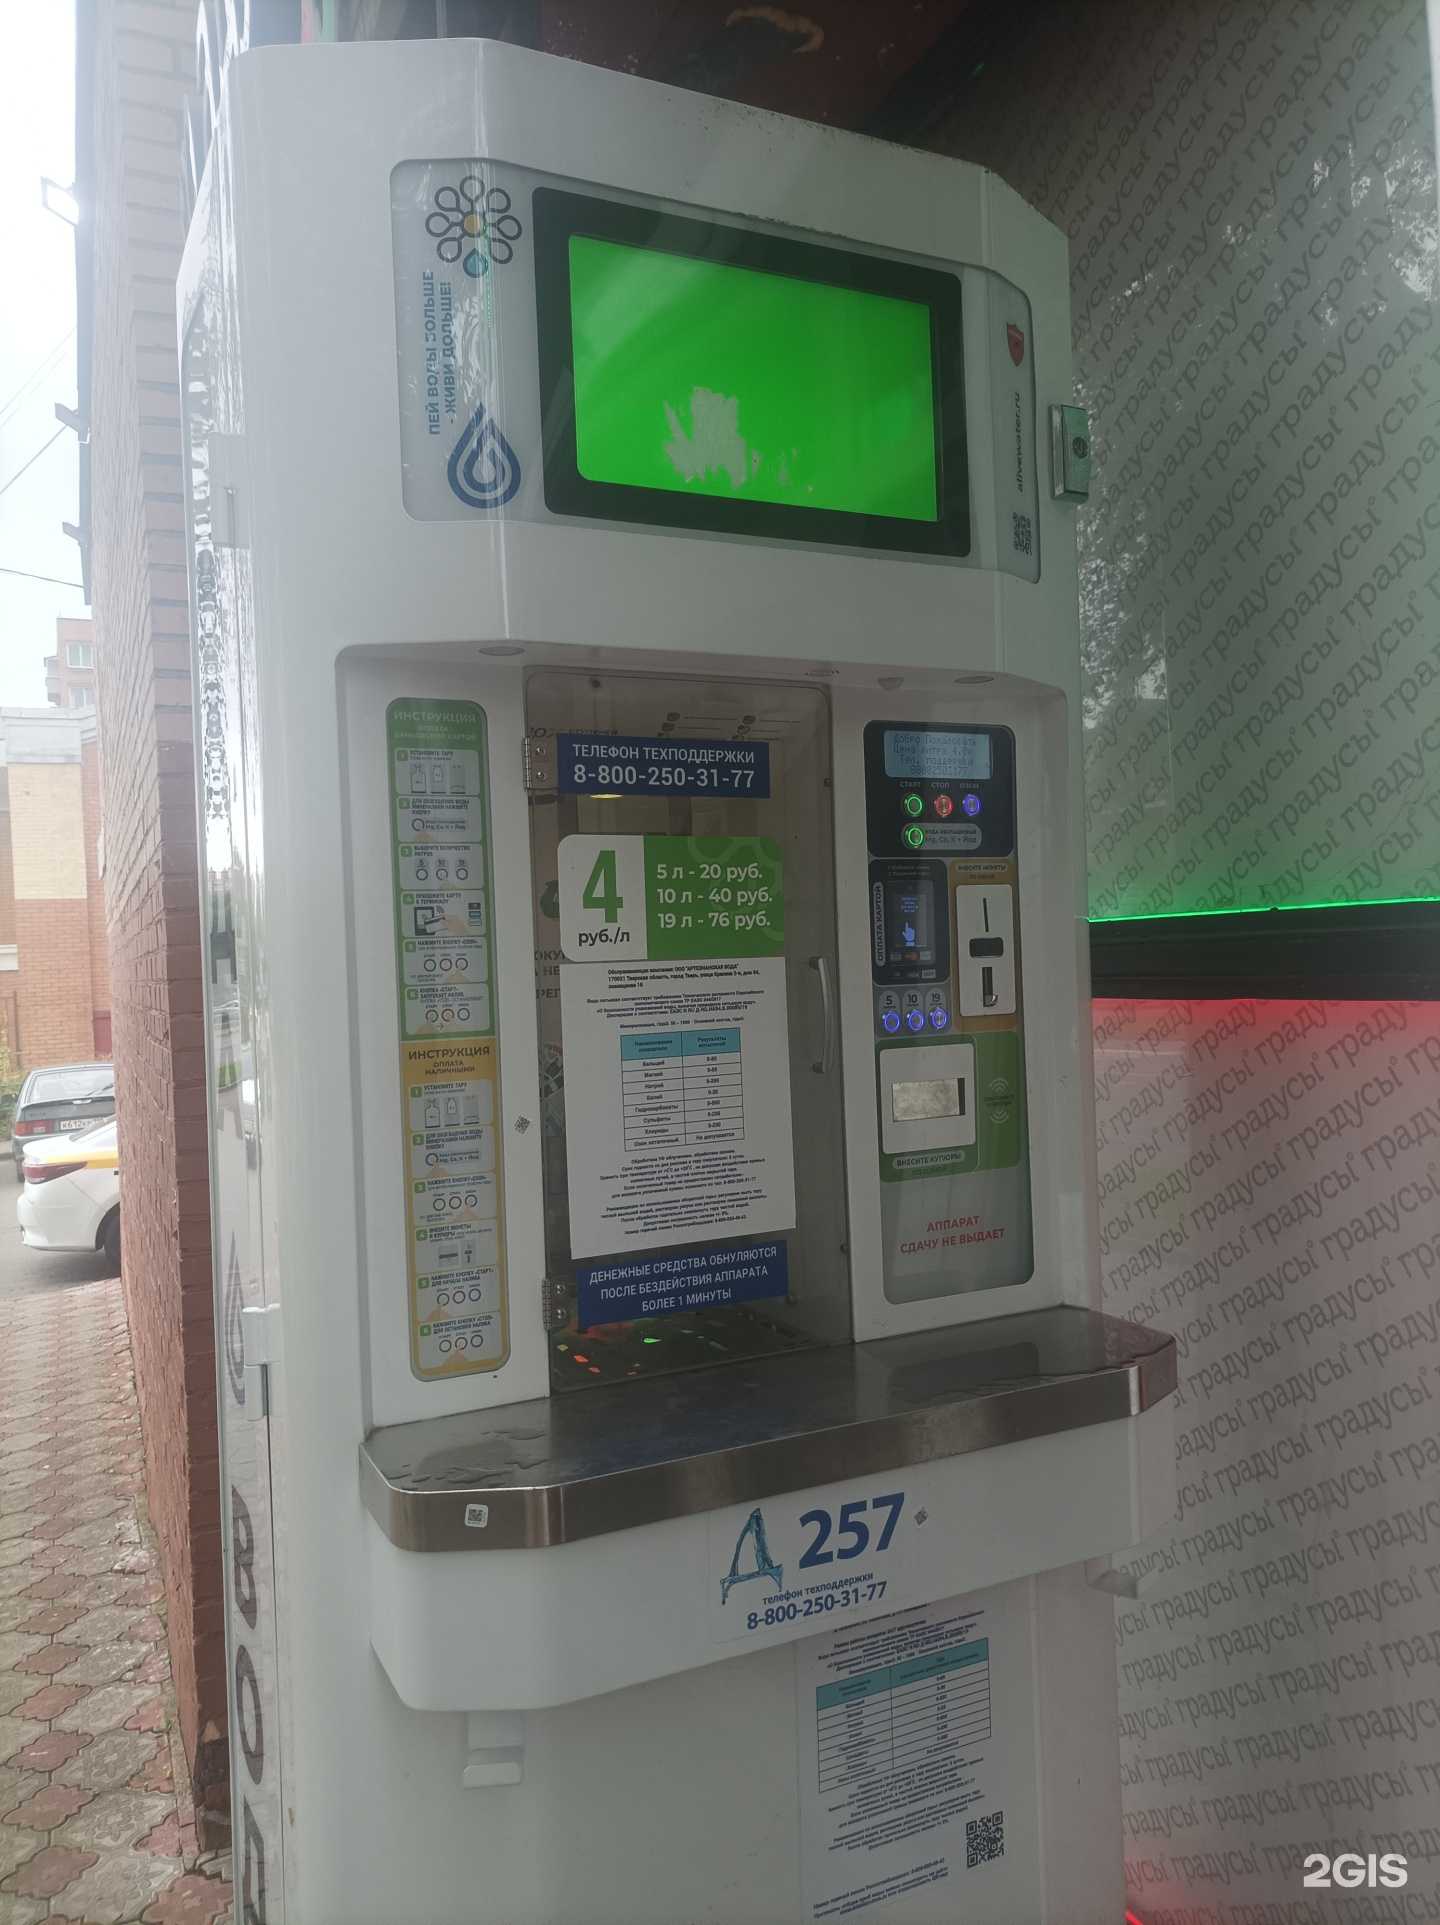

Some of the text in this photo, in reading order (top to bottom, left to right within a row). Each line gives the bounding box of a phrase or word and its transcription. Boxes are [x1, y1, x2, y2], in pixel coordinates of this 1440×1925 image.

[443, 364, 456, 414] ЖИВИ
[425, 402, 440, 435] ПЕЙ
[393, 711, 477, 723] ИНСТРУКЦИЯ
[572, 744, 755, 764] ТЕЛЕФОН ТЕХПОДДЕРЖКИ
[573, 764, 755, 788] 8-800-250-31-77
[656, 864, 667, 879] 5
[671, 867, 684, 879] л
[700, 864, 722, 879] 20
[727, 863, 763, 882] руб.
[582, 850, 624, 923] 4
[657, 889, 675, 903] 10
[680, 891, 693, 904] л
[708, 888, 732, 903] 40
[736, 887, 773, 906] руб.
[657, 913, 676, 928] 19
[680, 916, 693, 929] л
[708, 911, 729, 927] 76
[735, 912, 771, 930] руб.
[578, 928, 631, 946] руб./л
[885, 995, 893, 1005] 5
[907, 994, 918, 1004] 10
[931, 993, 941, 1002] 19
[408, 1047, 490, 1061] ИНСТРУКЦИЯ
[927, 1215, 981, 1233] АППАРАТ
[901, 1238, 938, 1254] СДАЧУ
[942, 1233, 957, 1247] НЕ
[589, 1246, 777, 1287] ДЕНЕЖНЫЕ СРЕДСТВА ОБНУЛЯЮТСЯ
[600, 1265, 769, 1299] ПОСЛЕ БЕЗДЕЙСТВИЯ АППАРАТА
[642, 1288, 732, 1312] БОЛЕЕ 1 МИНУТЫ
[799, 1492, 905, 1570] 257
[719, 1507, 784, 1606] Д
[762, 1572, 874, 1606] телефон техподдержки
[747, 1581, 888, 1630] 8-800-250-31-77
